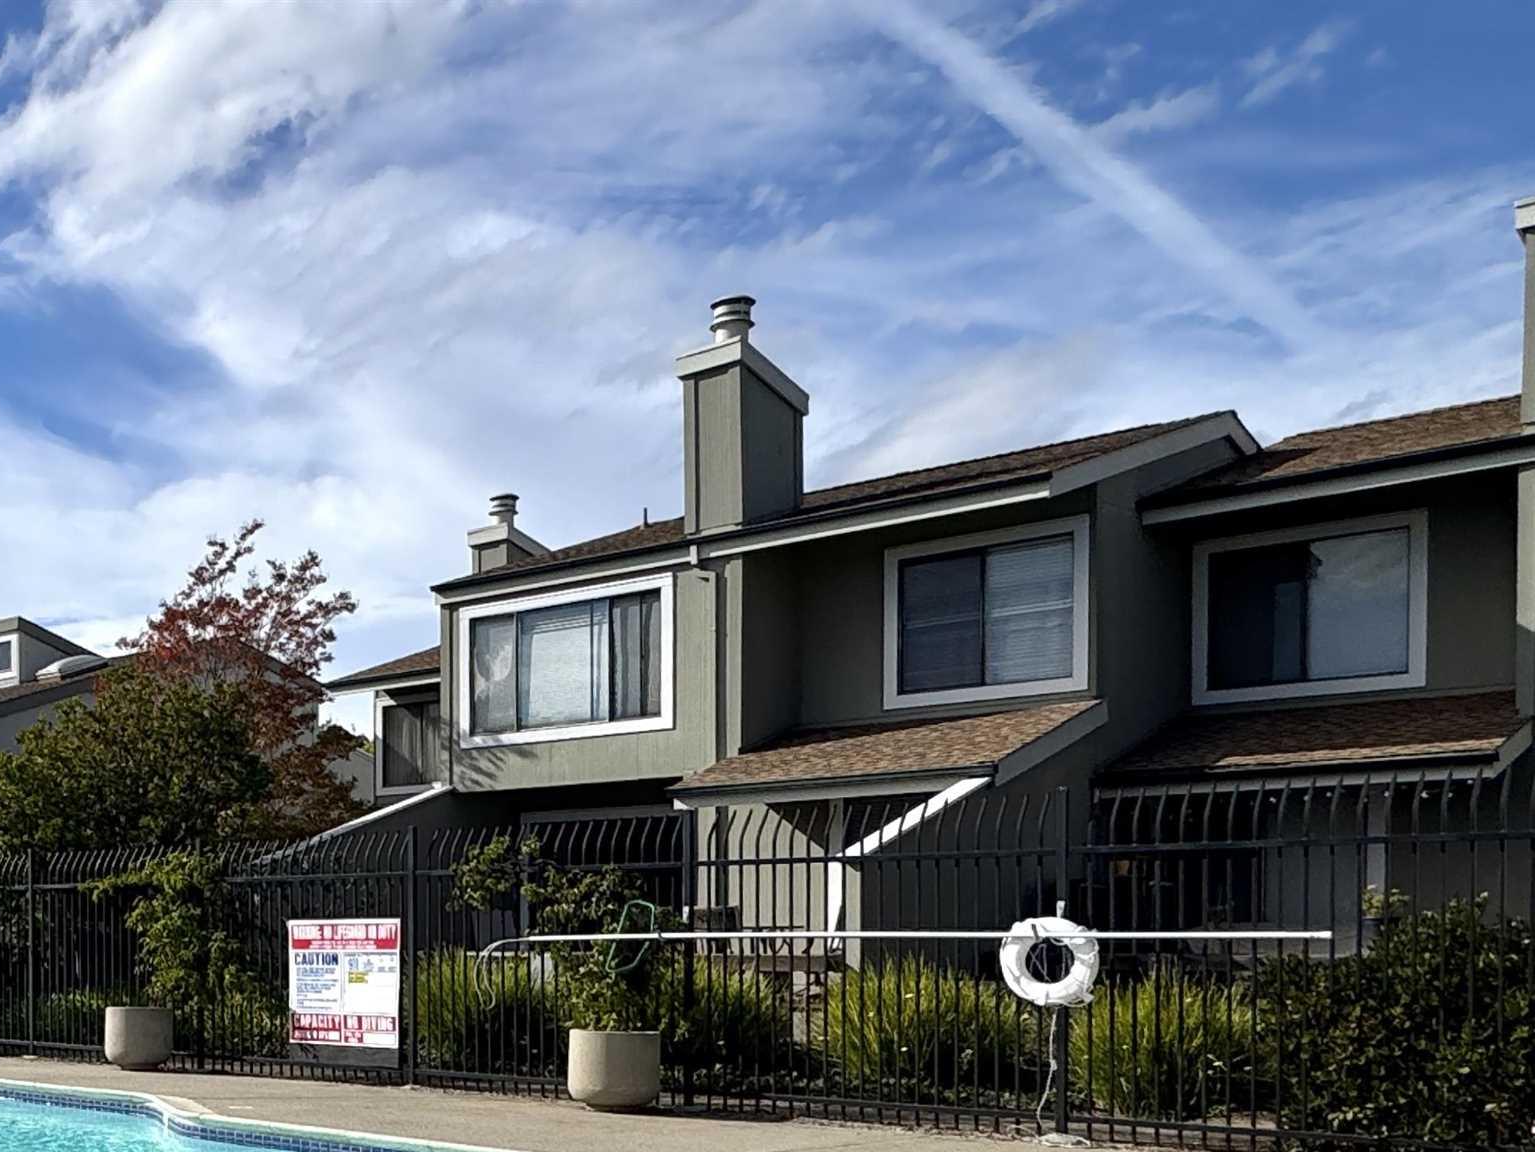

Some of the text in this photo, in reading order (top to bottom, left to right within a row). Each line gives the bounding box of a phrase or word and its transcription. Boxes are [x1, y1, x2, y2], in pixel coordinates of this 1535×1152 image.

[378, 923, 396, 940] DUTY
[294, 952, 339, 965] CAUTION
[293, 1013, 339, 1029] CAPACITY
[346, 1015, 394, 1031] NO DIVING
